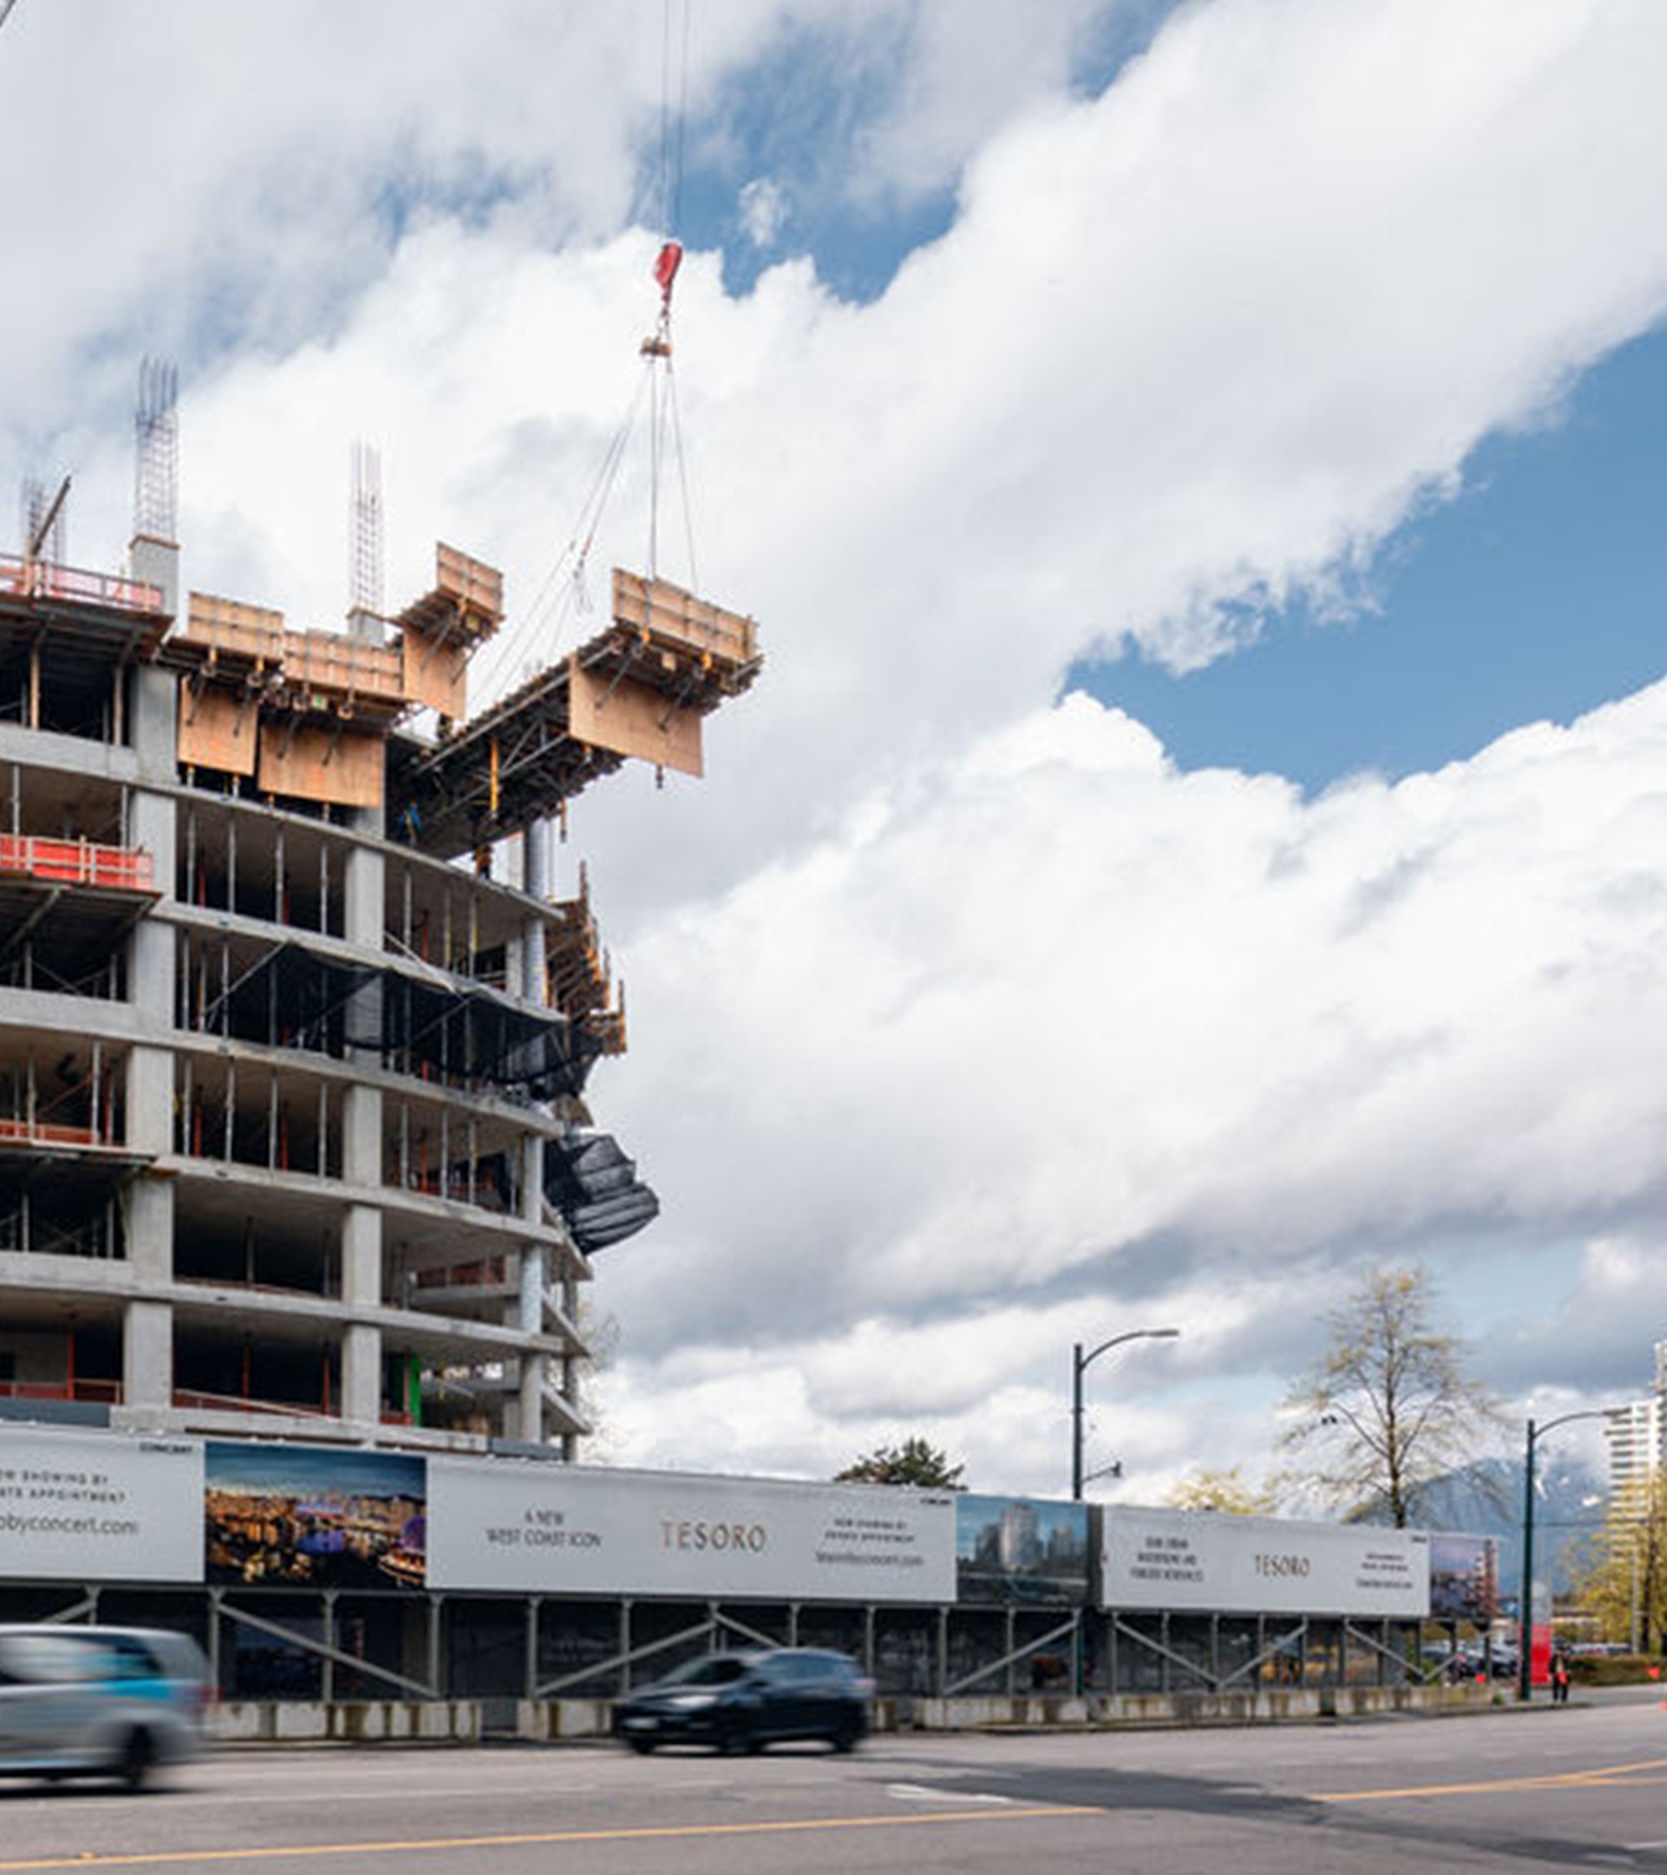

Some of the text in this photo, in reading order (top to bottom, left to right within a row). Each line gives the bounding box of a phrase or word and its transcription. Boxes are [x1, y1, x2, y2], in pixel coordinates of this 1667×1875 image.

[22, 1470, 87, 1486] SHOWING
[92, 1474, 108, 1486] BY
[30, 1488, 125, 1502] APPOINTMENT
[486, 1528, 521, 1545] WEST
[660, 1521, 767, 1552] TESORO
[1254, 1553, 1310, 1578] TESORO
